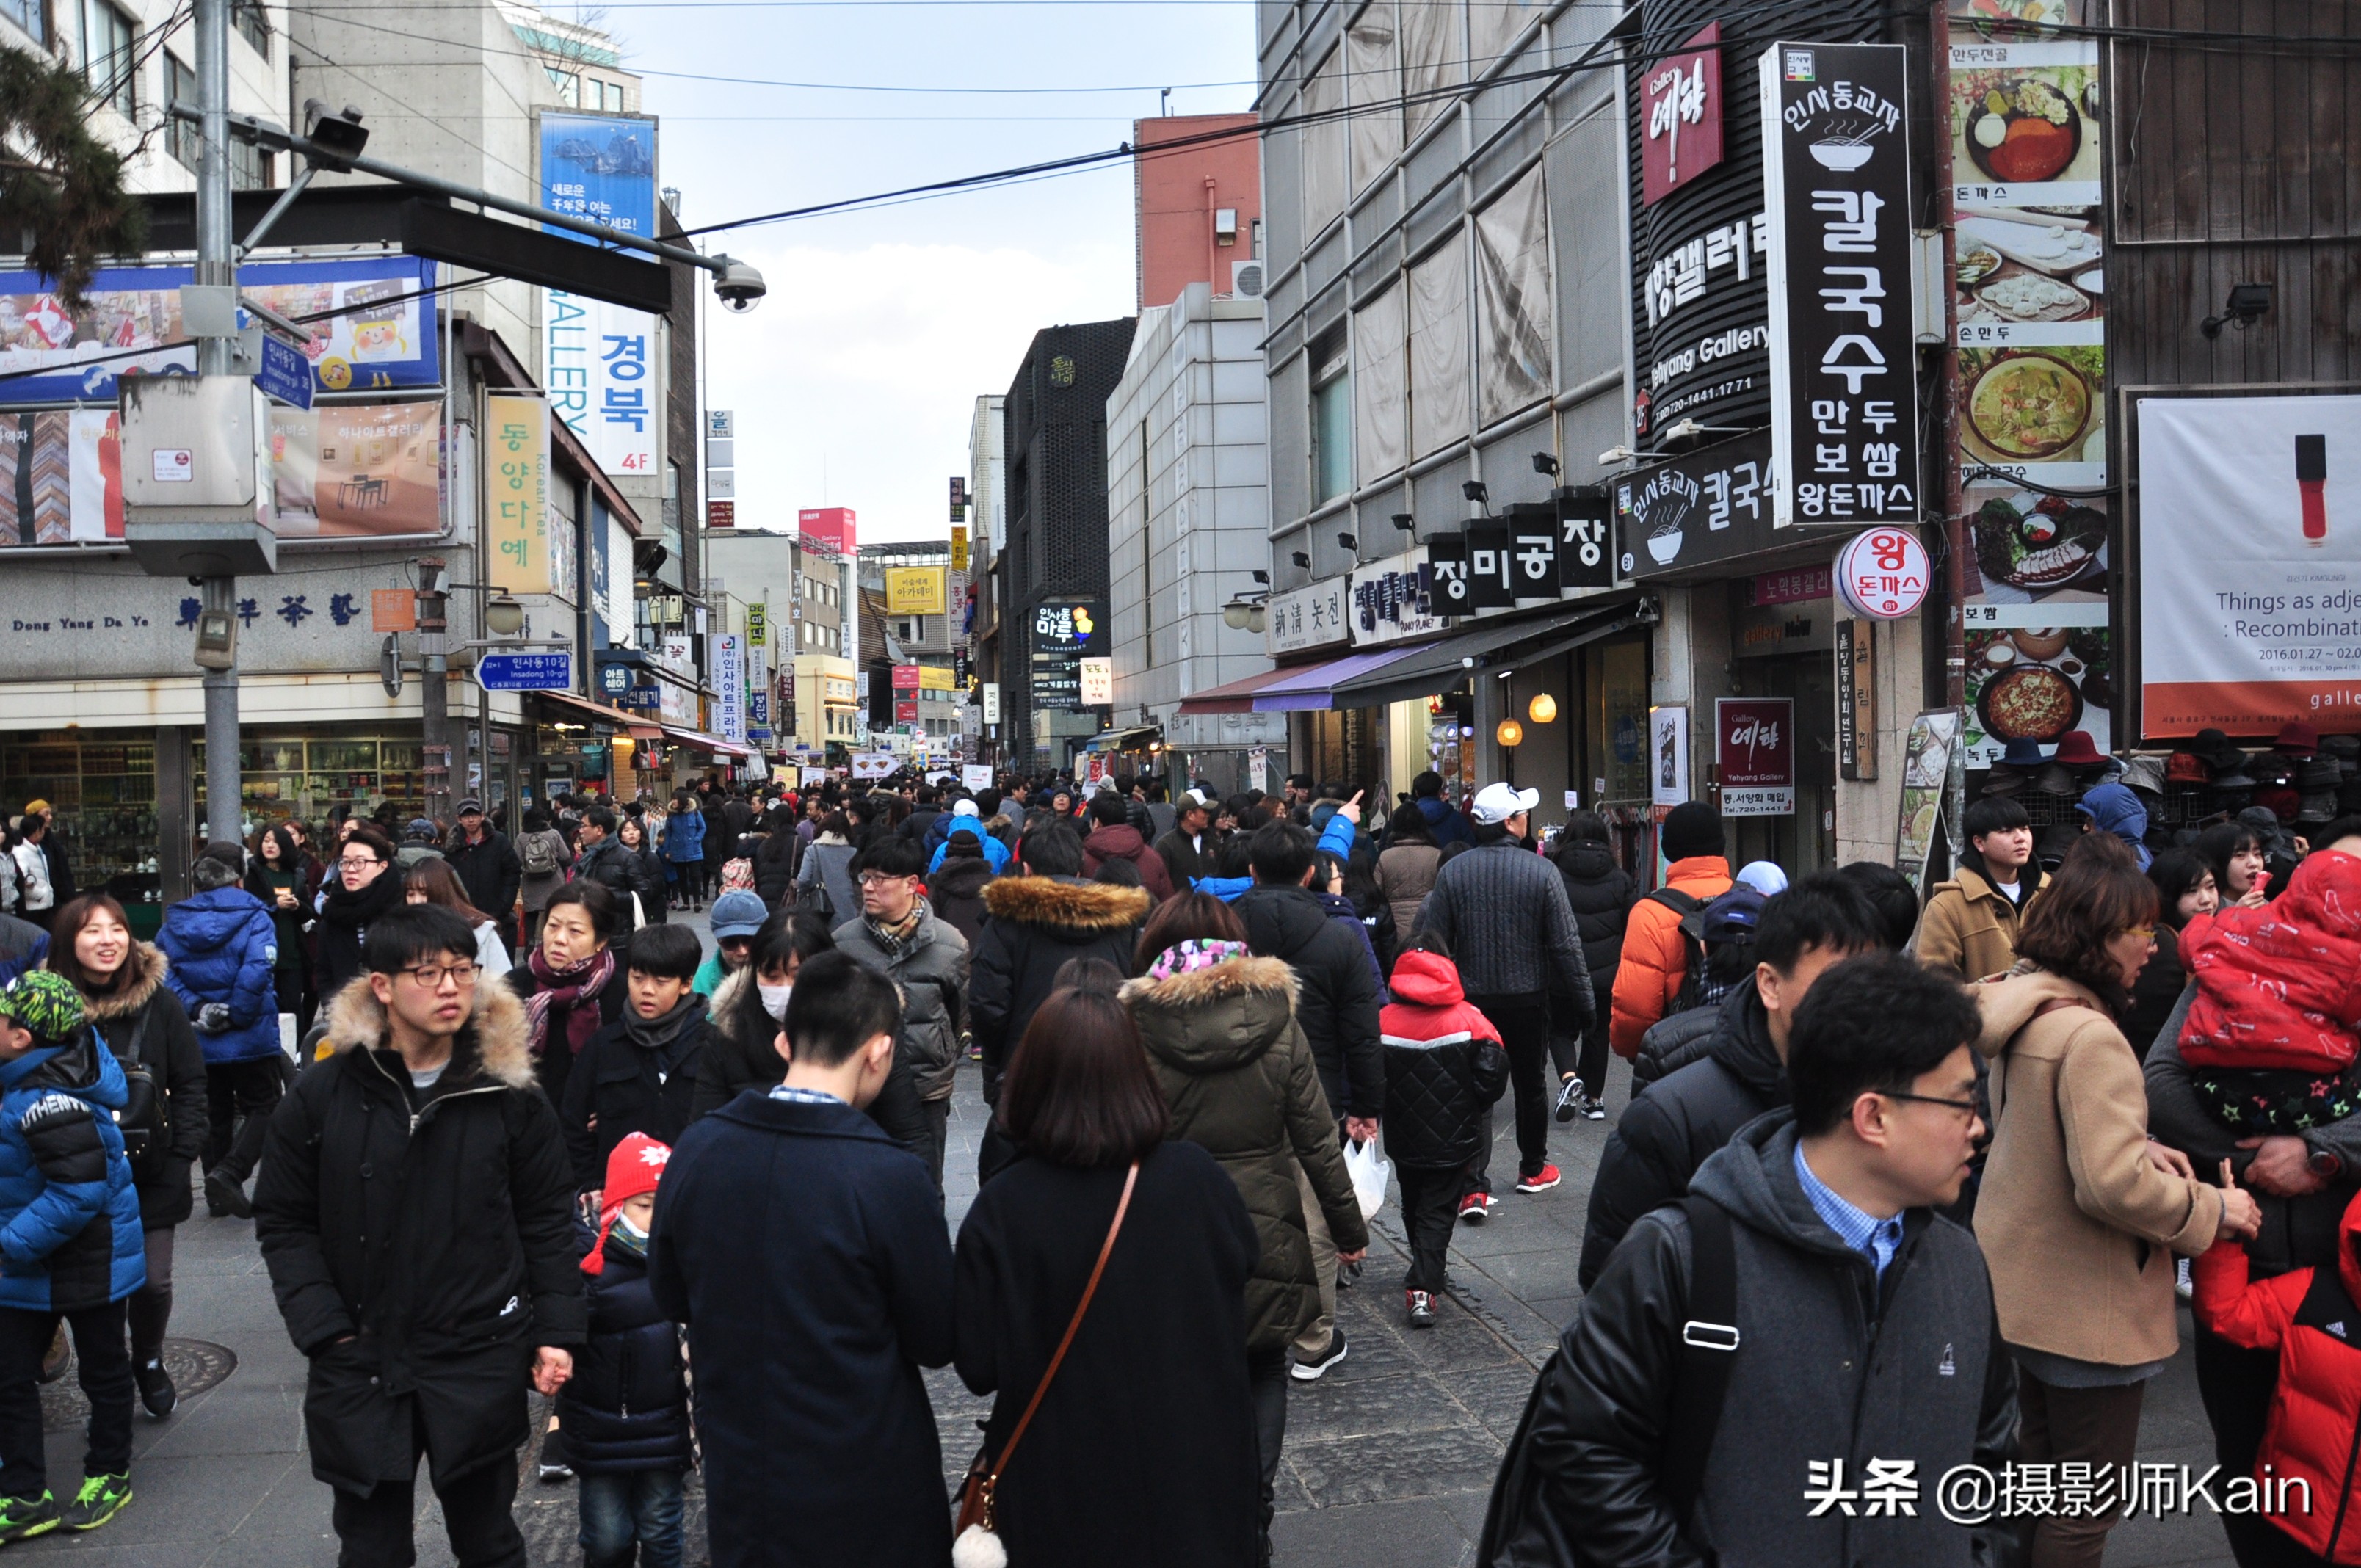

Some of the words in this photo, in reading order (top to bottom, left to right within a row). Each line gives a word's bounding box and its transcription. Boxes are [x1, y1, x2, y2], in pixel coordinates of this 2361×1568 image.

[1952, 46, 2008, 62] 만두전골
[1784, 81, 1901, 133] 인사동교자
[552, 183, 585, 197] 새로운
[1956, 186, 2008, 200] 돈까스
[590, 201, 612, 214] 여는
[1810, 189, 1888, 395] 칼국수
[1959, 327, 2010, 340] 손만두
[1699, 326, 1770, 363] Gallery
[600, 334, 649, 432] 경북
[621, 454, 648, 470] 4F
[1813, 443, 1901, 477] 보쌈
[535, 453, 548, 504] Korean
[499, 423, 529, 568] 동양다예
[1633, 468, 1700, 524] 인사동교자
[1798, 482, 1914, 516] 왕돈까스
[536, 511, 548, 537] Tea
[1434, 519, 1606, 600] 장미공장
[1871, 535, 1909, 571] 왕
[1622, 556, 1632, 570] B1
[897, 586, 933, 598] 아카데미
[1858, 576, 1921, 597] 돈까스
[1885, 600, 1896, 611] B1
[2216, 591, 2285, 615] Things
[2293, 596, 2315, 609] as
[1040, 608, 1070, 620] 인사동
[13, 620, 51, 631] Dong
[59, 618, 95, 630] Yang
[104, 617, 123, 628] Da
[1036, 620, 1073, 644] 마루
[512, 656, 567, 669] 인사동10길
[2259, 648, 2322, 661] 2016.01.27
[510, 670, 544, 679] Insadong
[546, 669, 567, 678] 10-gil
[605, 669, 625, 679] 아트
[1731, 714, 1757, 724] Gallery
[1760, 774, 1785, 782] Gallery
[1724, 793, 1764, 805] 동.서양화
[1766, 792, 1785, 803] 매입
